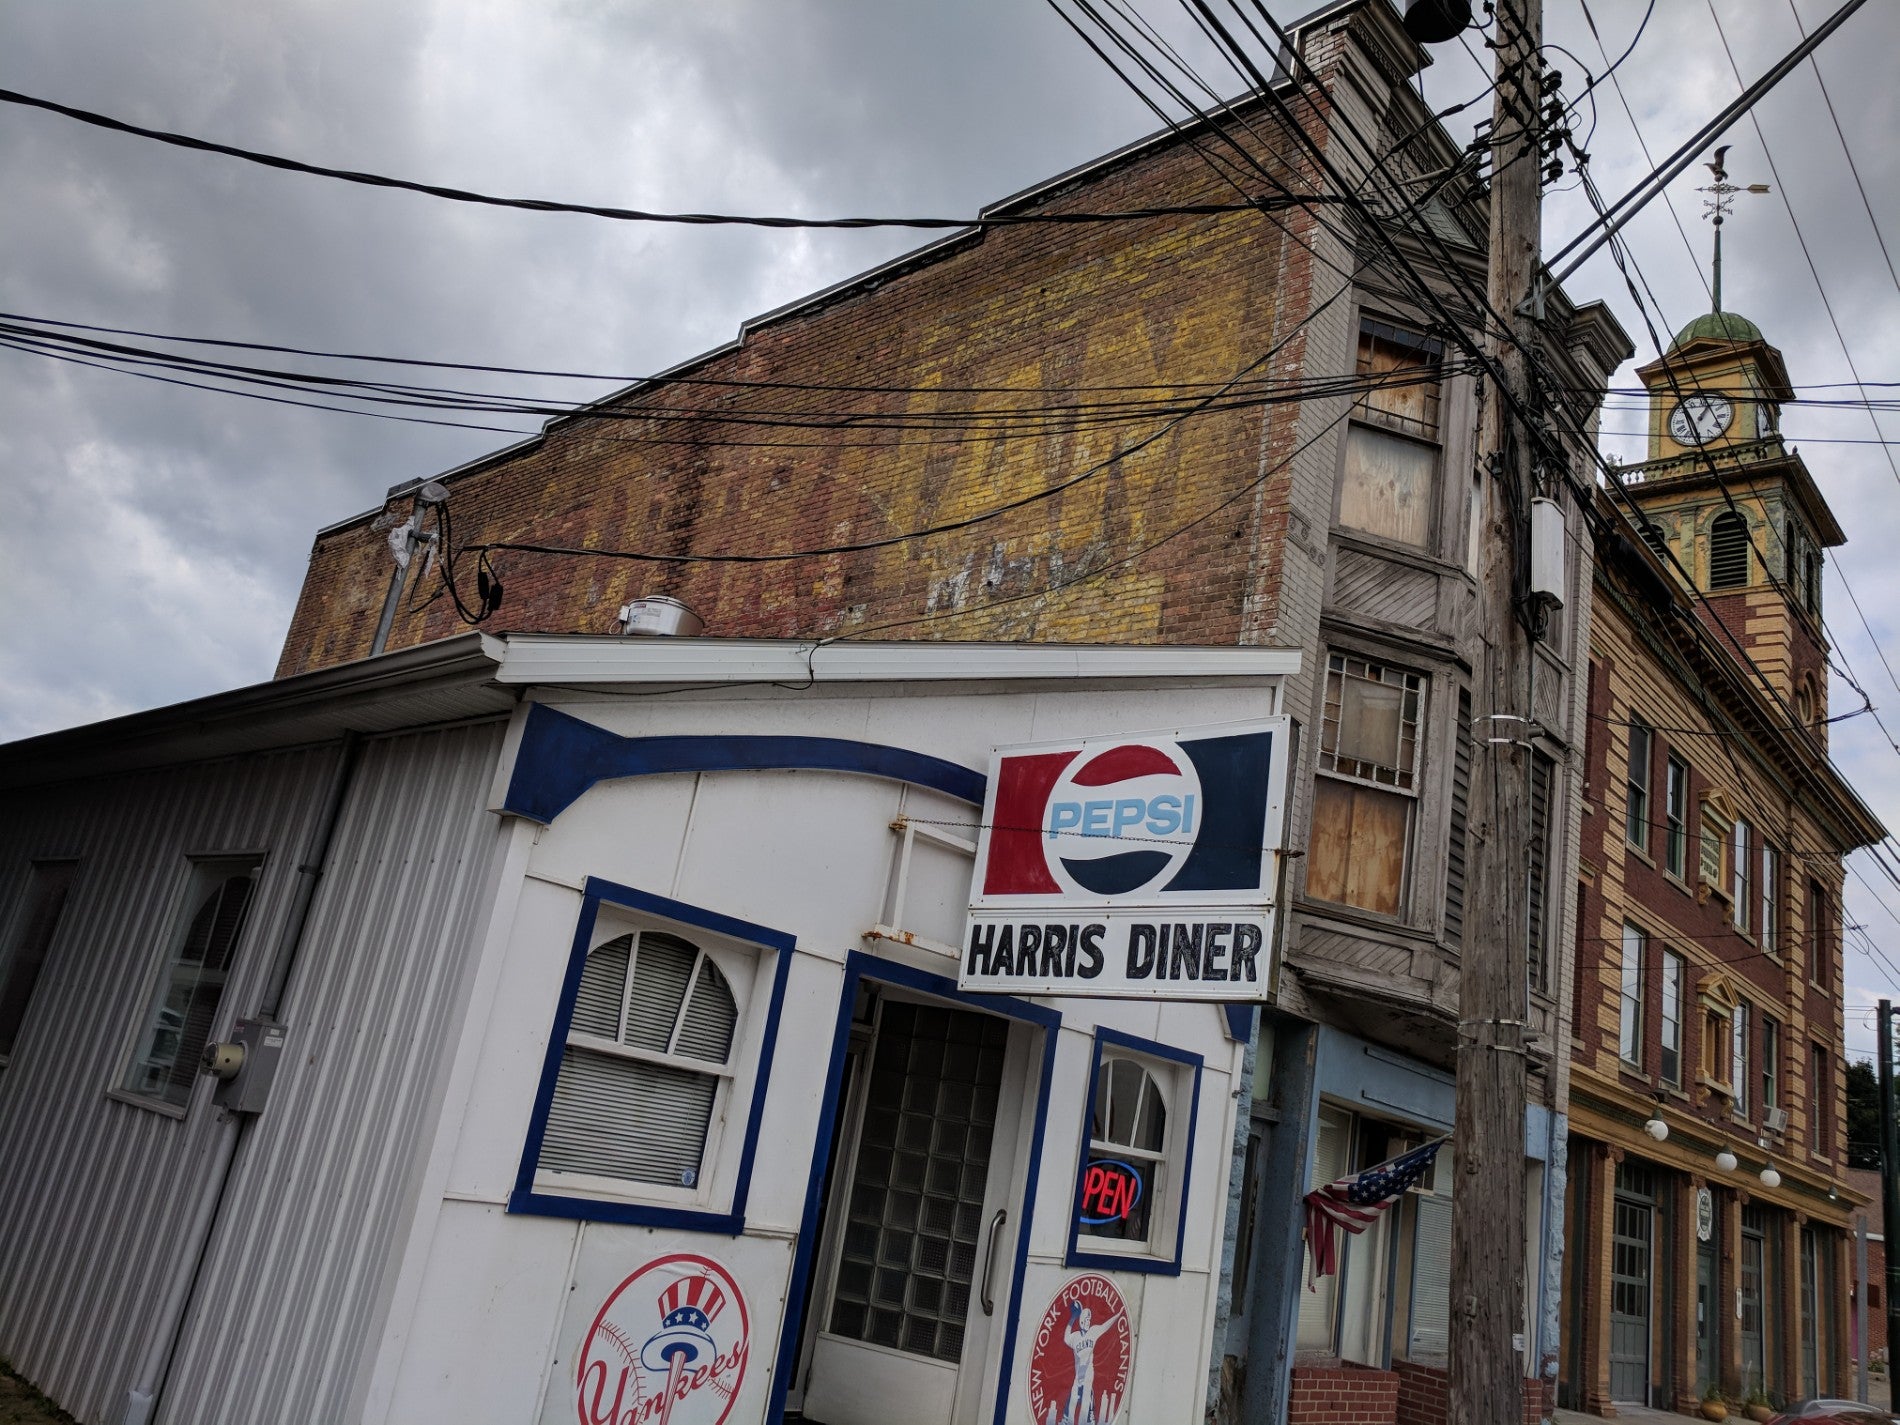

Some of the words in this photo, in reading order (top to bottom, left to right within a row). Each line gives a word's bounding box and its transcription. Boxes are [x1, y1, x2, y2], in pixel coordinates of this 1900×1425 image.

[1049, 794, 1195, 839] PEPSI
[966, 923, 1106, 979] HARRIS
[1126, 923, 1263, 982] DINER
[1082, 1166, 1137, 1219] PEN
[1062, 1278, 1119, 1313] FOOTBALL
[1034, 1305, 1062, 1360] YORK
[1113, 1315, 1128, 1393] GIANTS
[581, 1340, 744, 1425] Yankees
[1031, 1369, 1048, 1419] NEW
